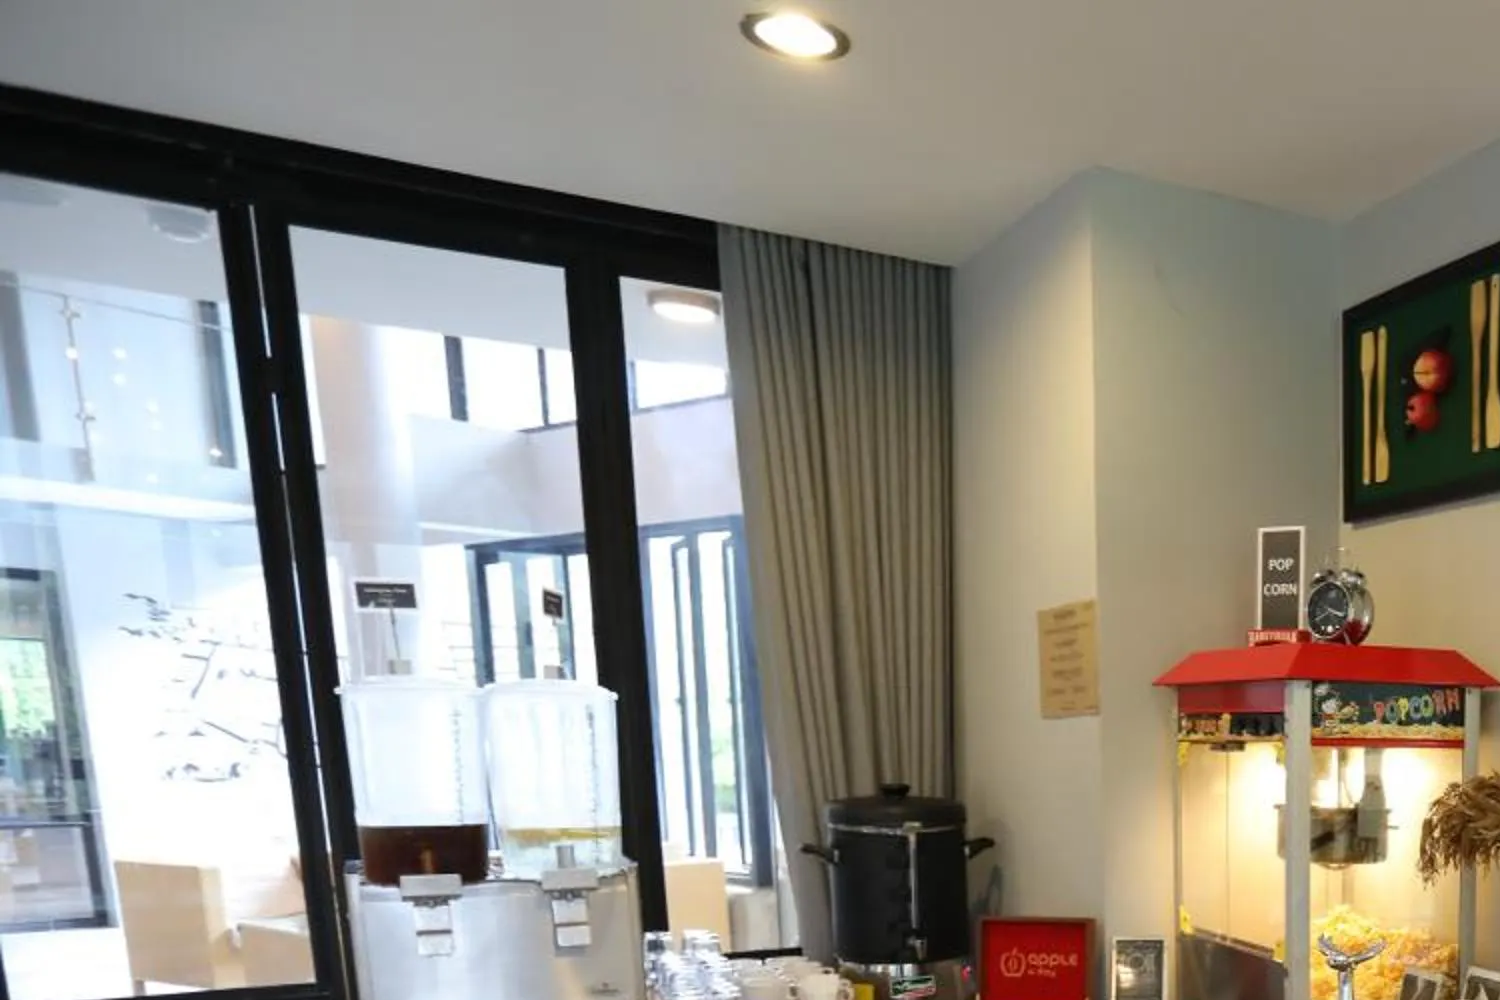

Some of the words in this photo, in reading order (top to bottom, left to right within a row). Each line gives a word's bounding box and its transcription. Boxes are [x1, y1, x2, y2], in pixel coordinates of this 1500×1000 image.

[1268, 557, 1295, 572] POP
[1263, 583, 1298, 597] CORN
[1374, 688, 1460, 722] POPCORN
